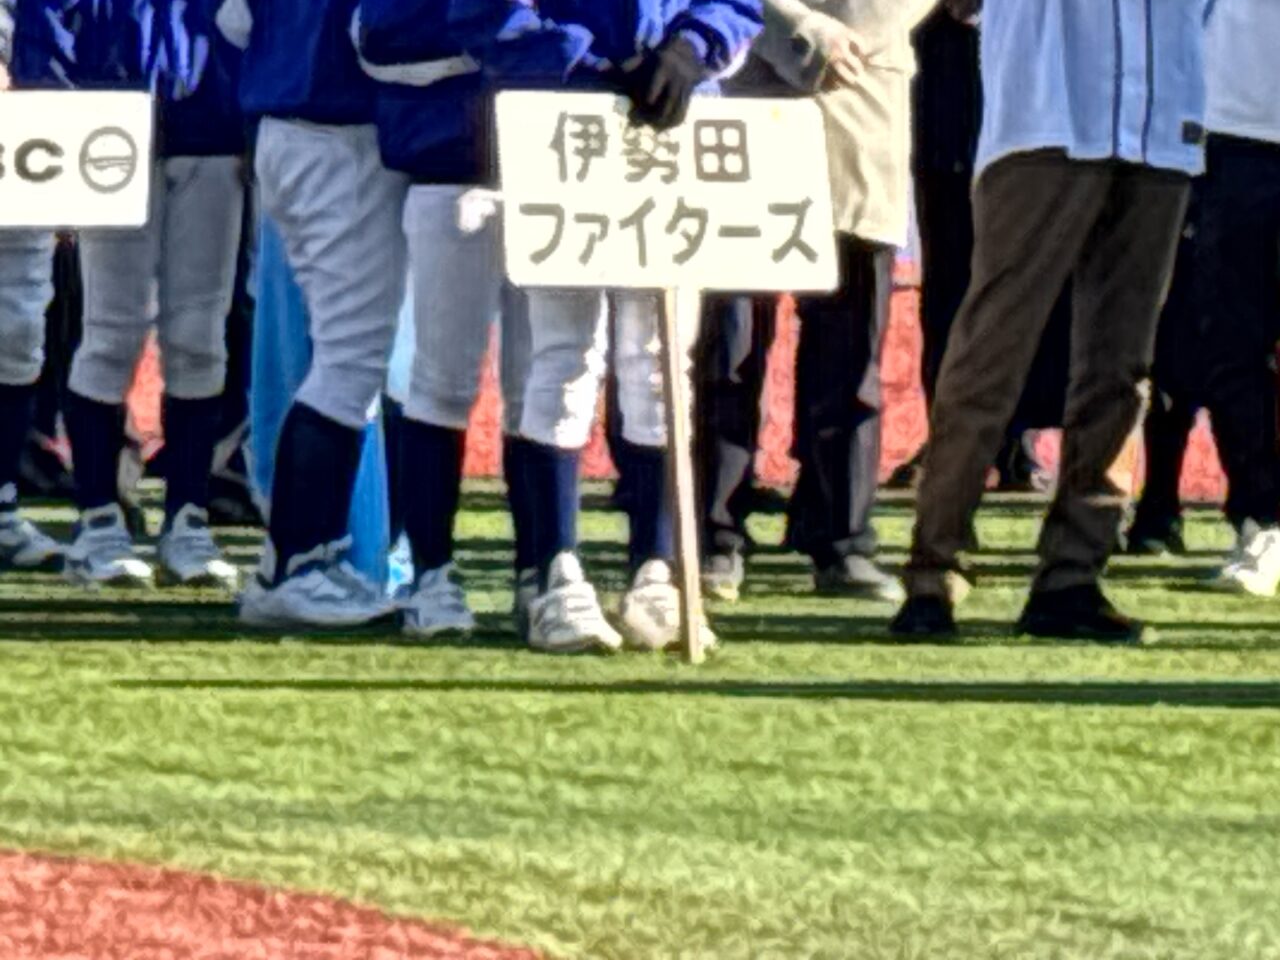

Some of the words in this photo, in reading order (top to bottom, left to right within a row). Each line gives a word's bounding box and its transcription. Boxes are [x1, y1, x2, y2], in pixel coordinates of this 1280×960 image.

[0, 138, 65, 183] C
[548, 111, 751, 184] 伊勢田
[518, 196, 819, 268] ファイターズ
